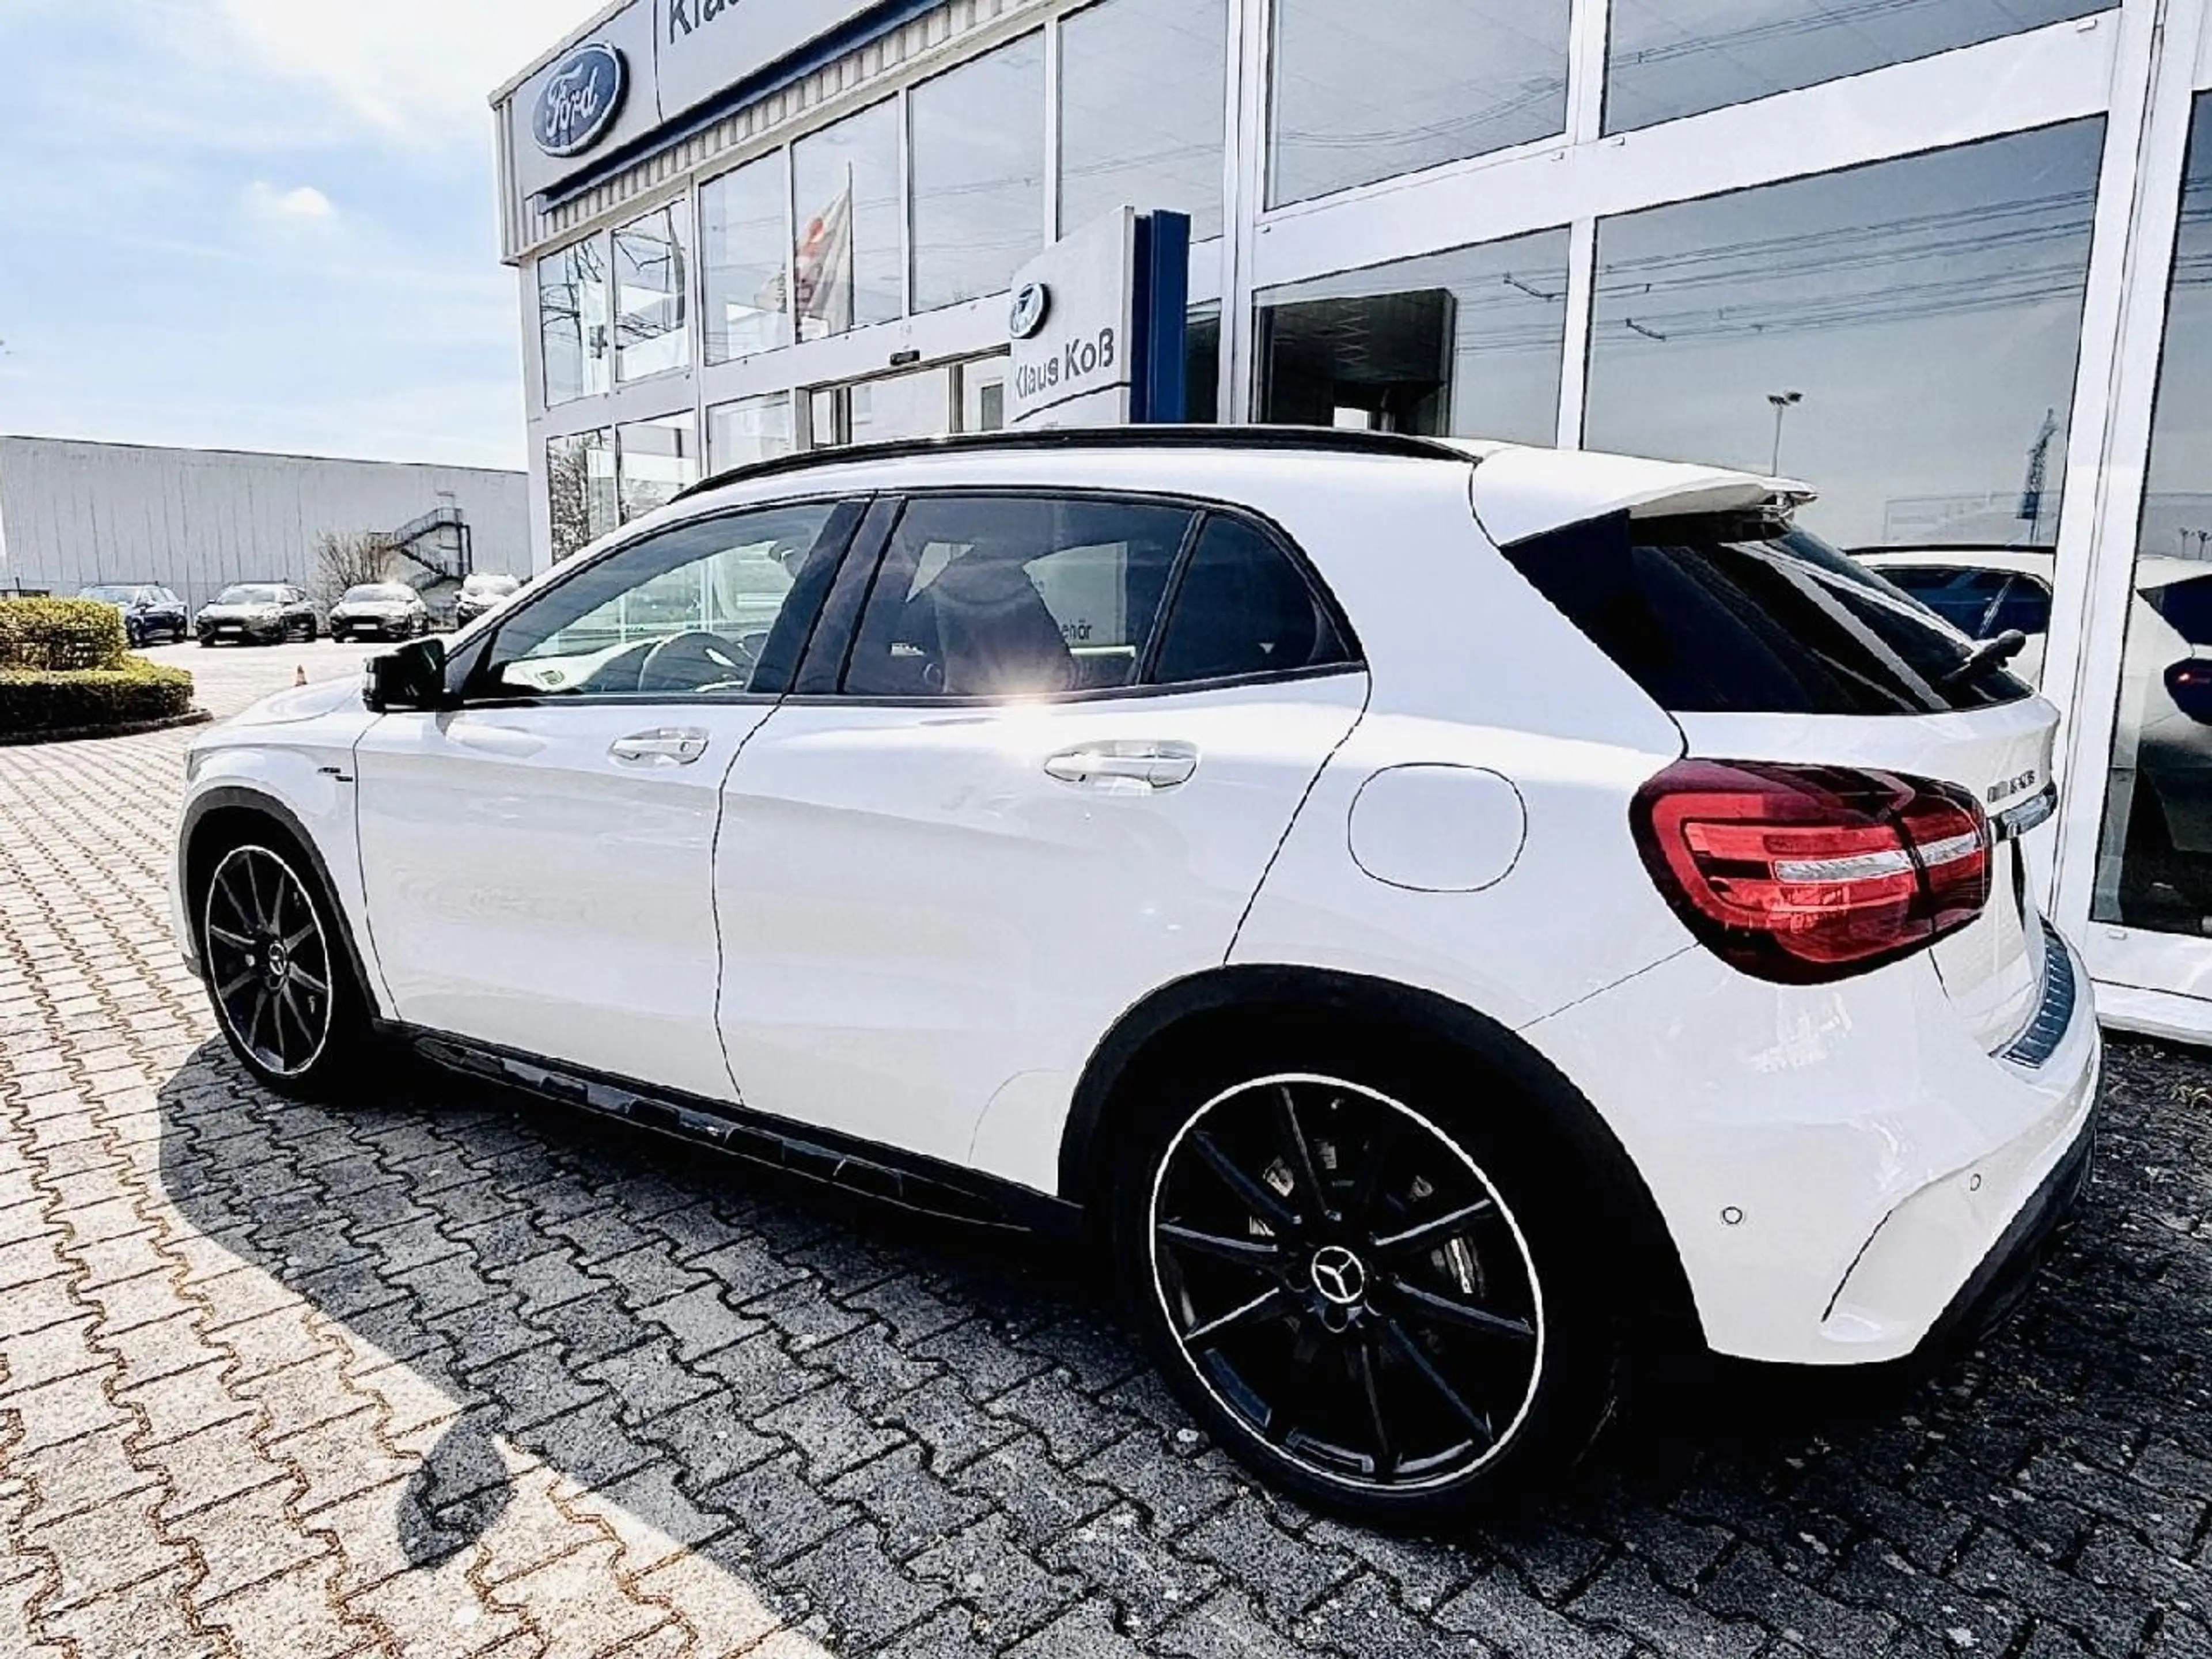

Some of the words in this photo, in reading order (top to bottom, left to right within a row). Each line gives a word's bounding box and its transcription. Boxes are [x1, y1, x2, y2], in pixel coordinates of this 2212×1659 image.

[546, 62, 599, 138] Ford
[1016, 357, 1059, 399] Klaus
[1065, 328, 1113, 381] Koß
[1062, 618, 1093, 640] ehör
